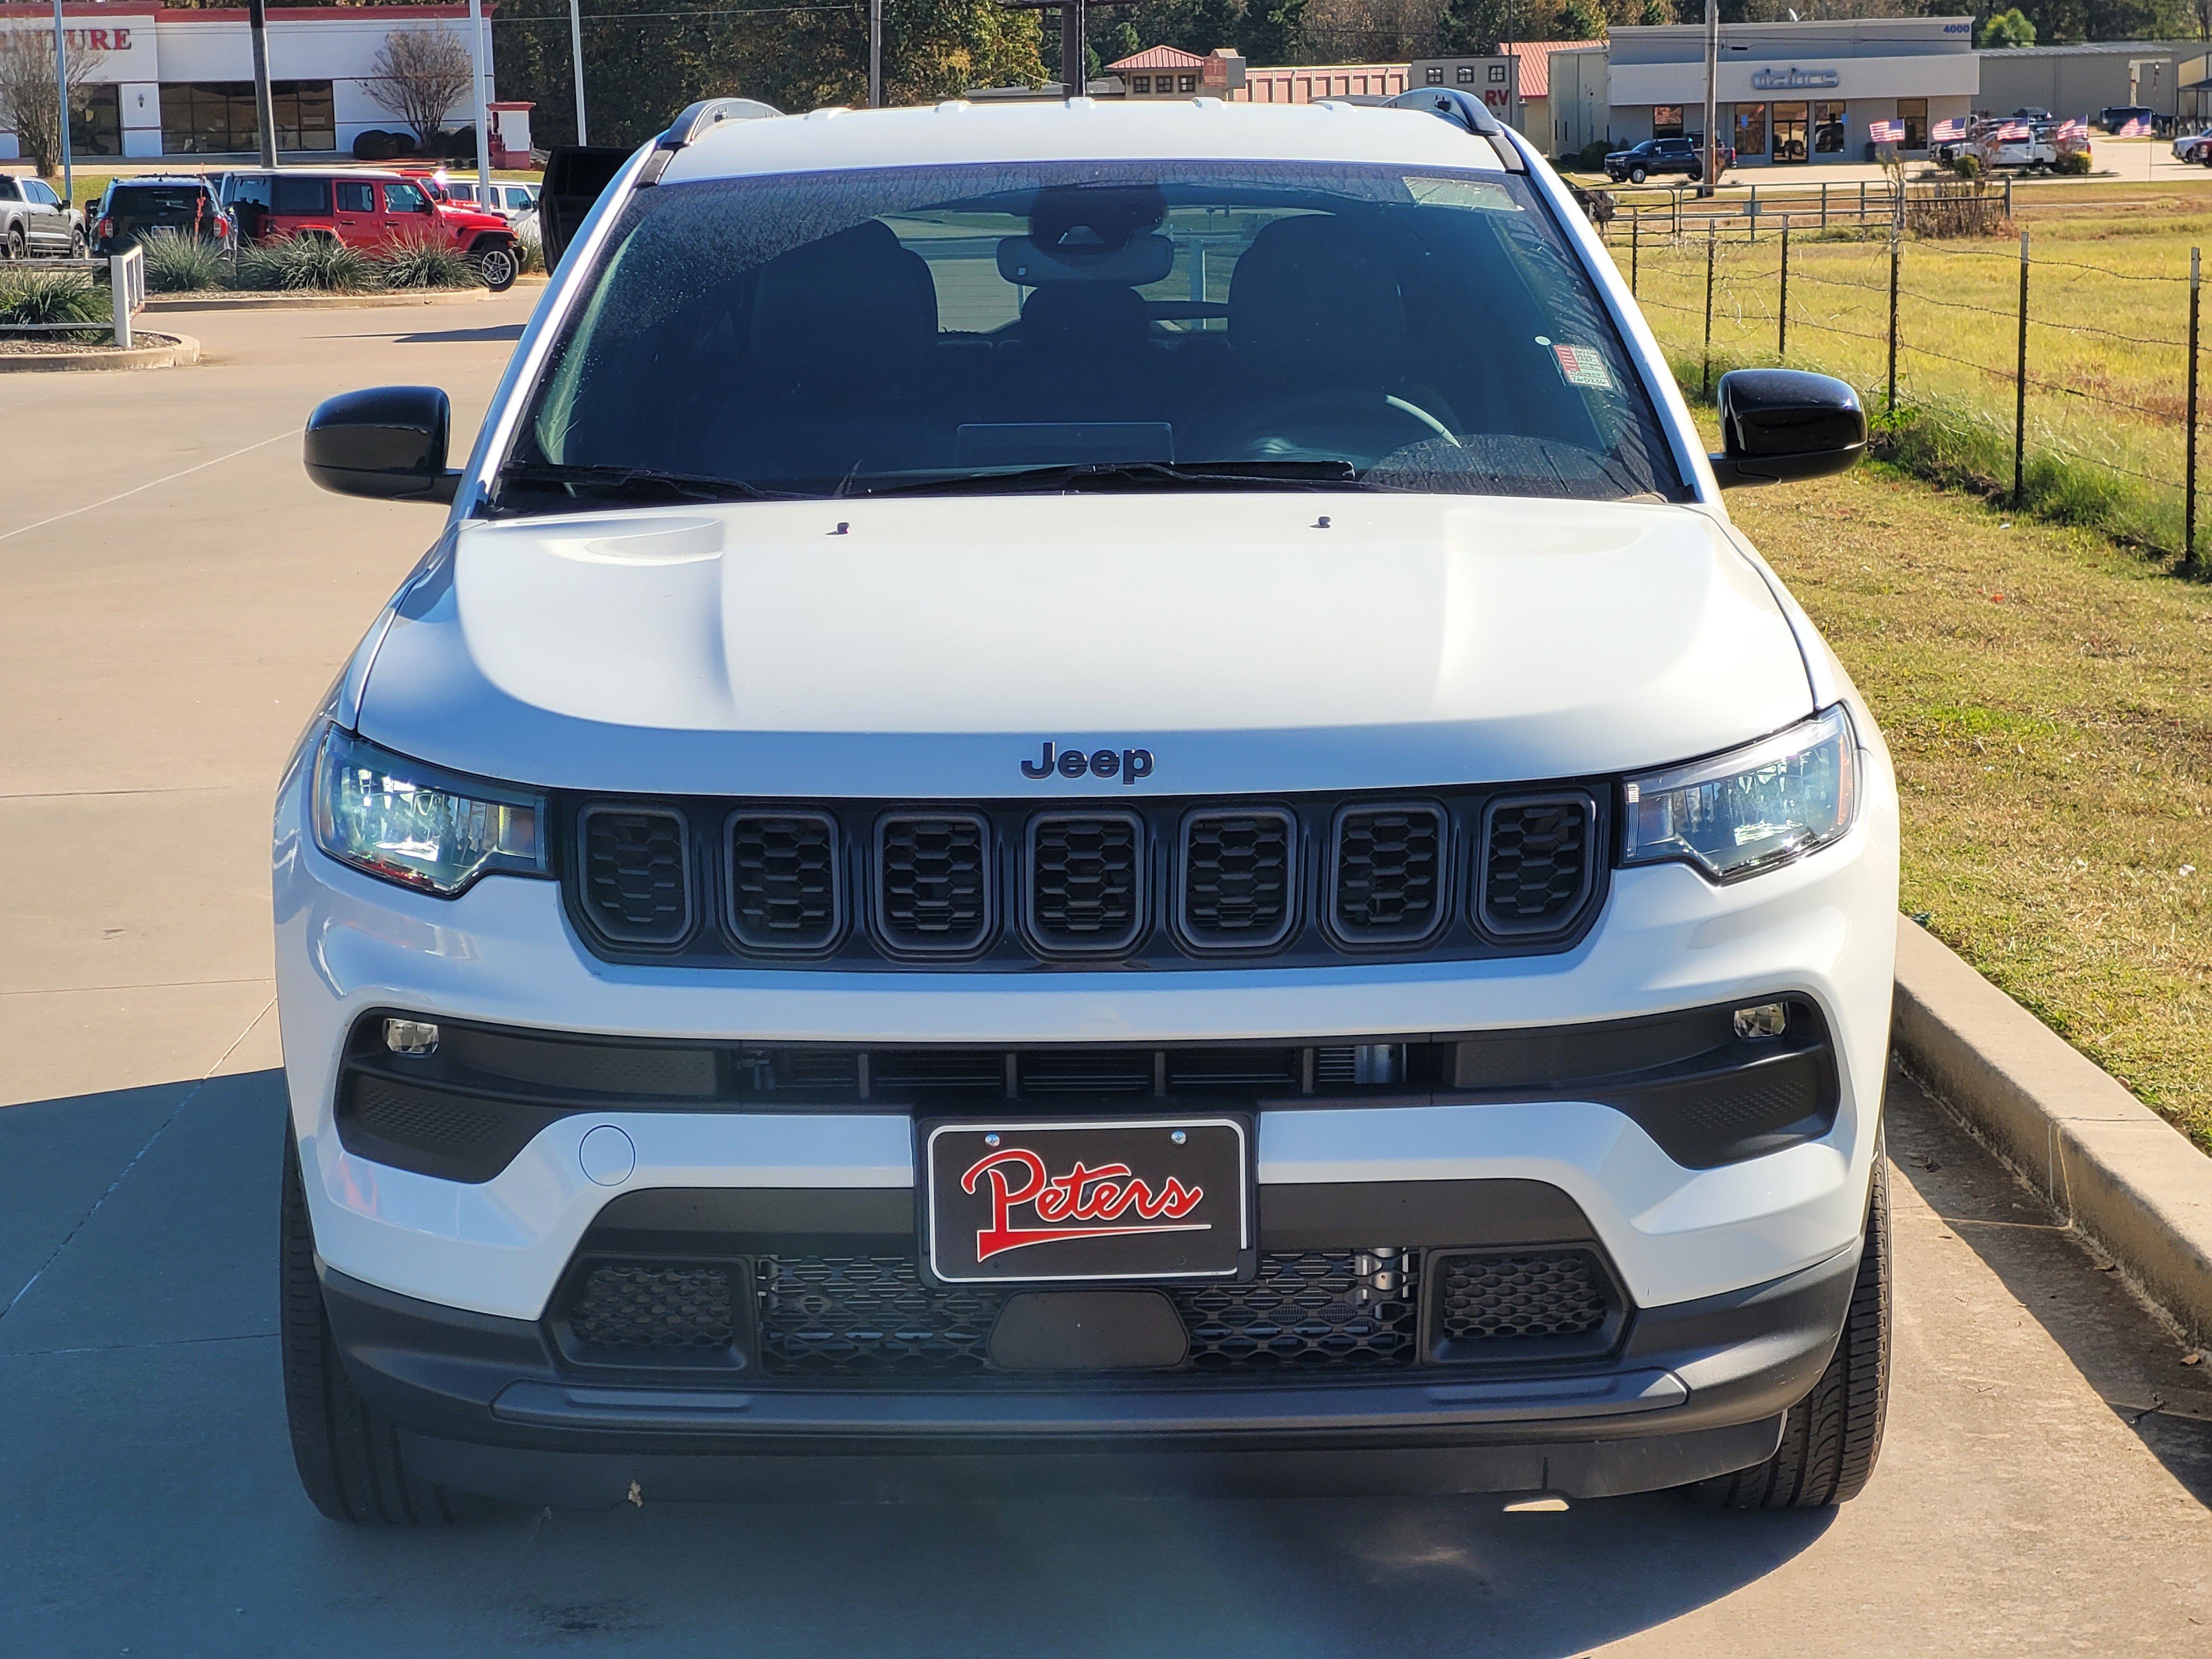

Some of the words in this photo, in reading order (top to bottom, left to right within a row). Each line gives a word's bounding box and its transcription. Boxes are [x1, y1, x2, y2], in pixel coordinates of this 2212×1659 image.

[1943, 25, 1970, 33] 4000
[1485, 89, 1509, 106] RV
[1020, 741, 1154, 785] Jeep
[961, 1149, 1204, 1235] Peters
